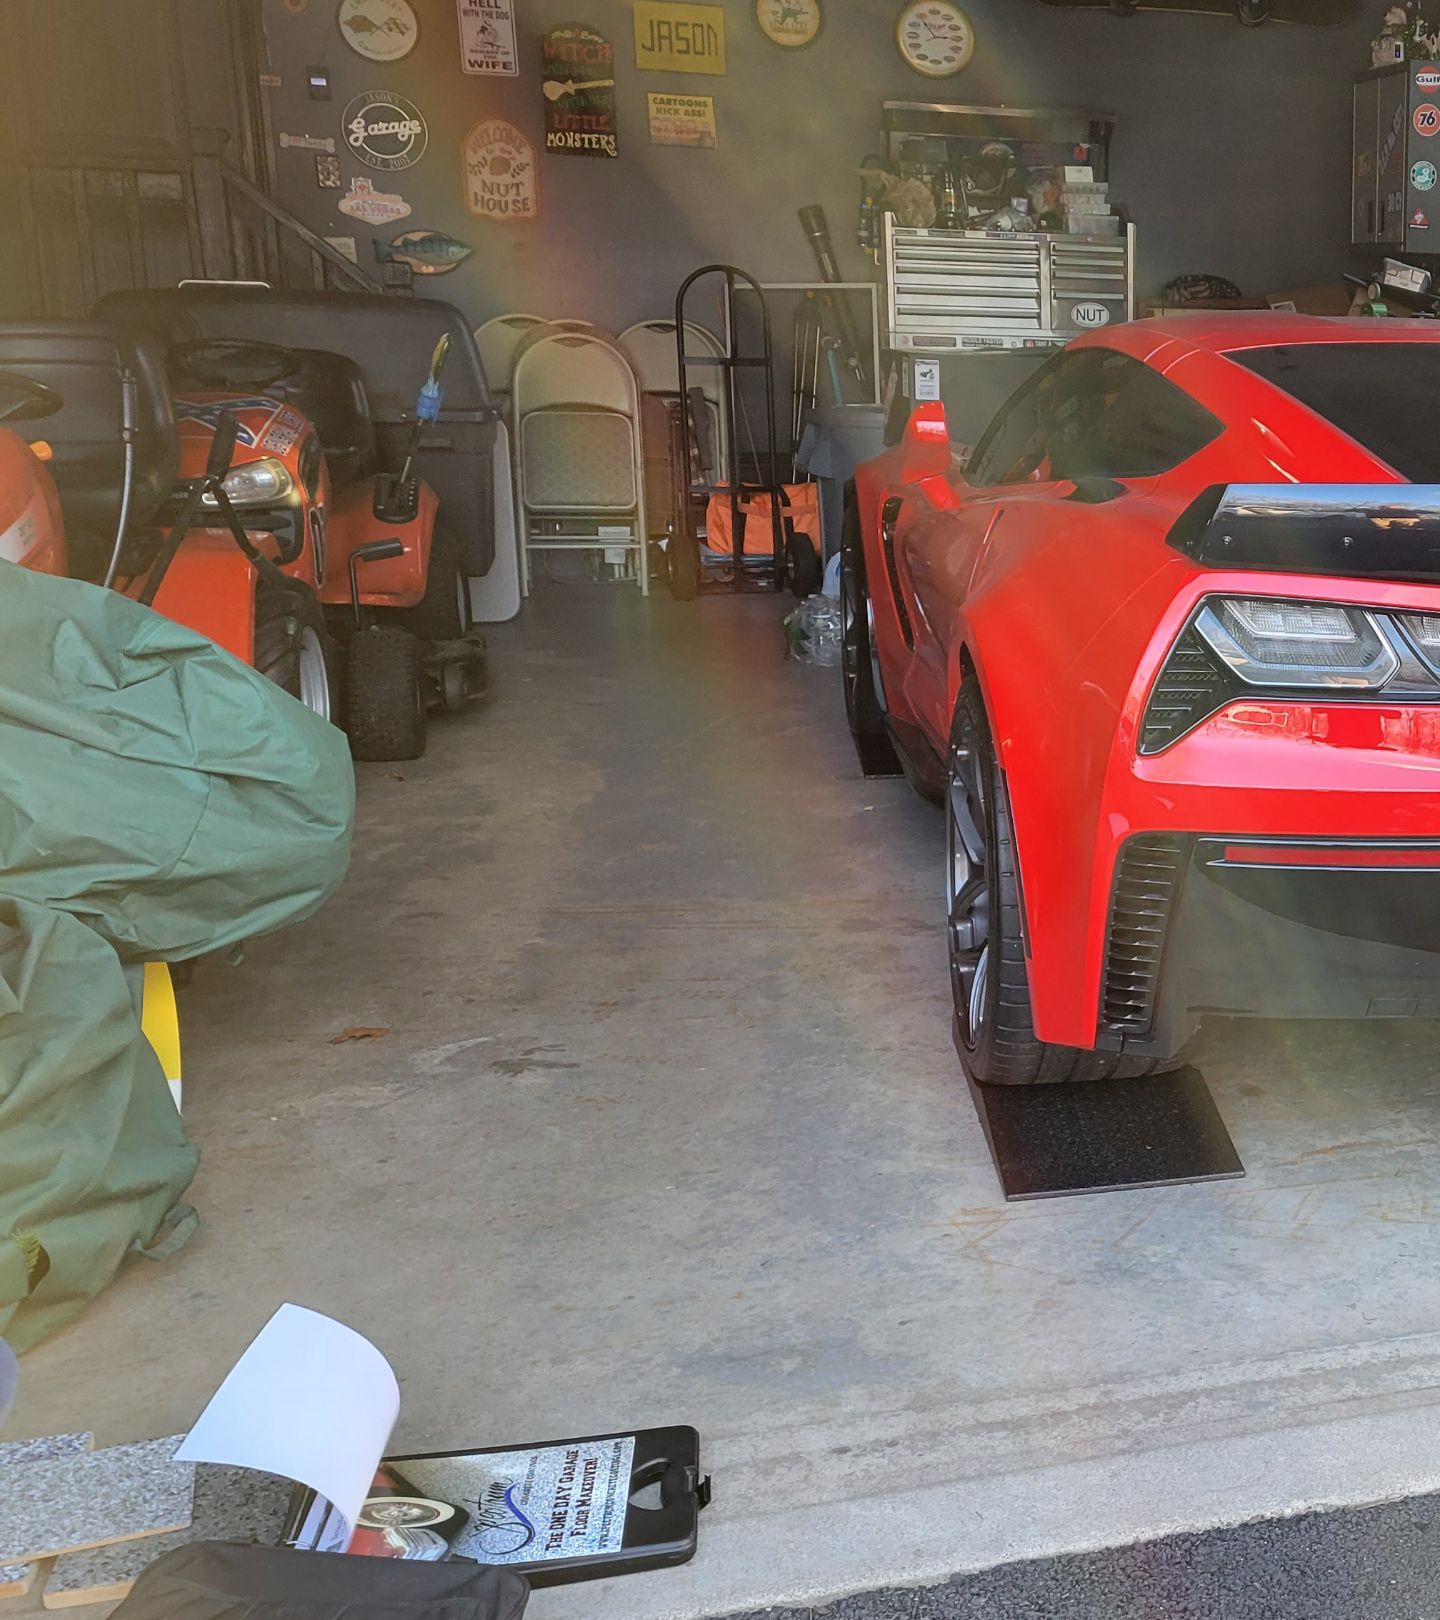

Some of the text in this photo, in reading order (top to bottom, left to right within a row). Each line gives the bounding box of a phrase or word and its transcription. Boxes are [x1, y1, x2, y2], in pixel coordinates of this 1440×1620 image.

[463, 9, 510, 20] WITH THE DOG
[469, 0, 502, 9] HELL
[641, 19, 719, 56] JASON
[468, 59, 514, 71] WIFE
[653, 97, 709, 109] CARTOONS
[656, 107, 707, 118] KICK ASS!
[1418, 110, 1437, 128] 76
[348, 117, 422, 147] Garage
[468, 126, 525, 154] WELCOME
[546, 132, 618, 157] MONSTERS
[481, 178, 525, 198] NUT
[474, 191, 531, 214] HOUSE
[1075, 308, 1105, 322] NUT
[559, 1449, 580, 1484] GARAGE
[554, 1486, 573, 1507] DAY
[570, 1456, 600, 1538] FLOOR MAKEOVER!
[550, 1507, 568, 1530] ONE
